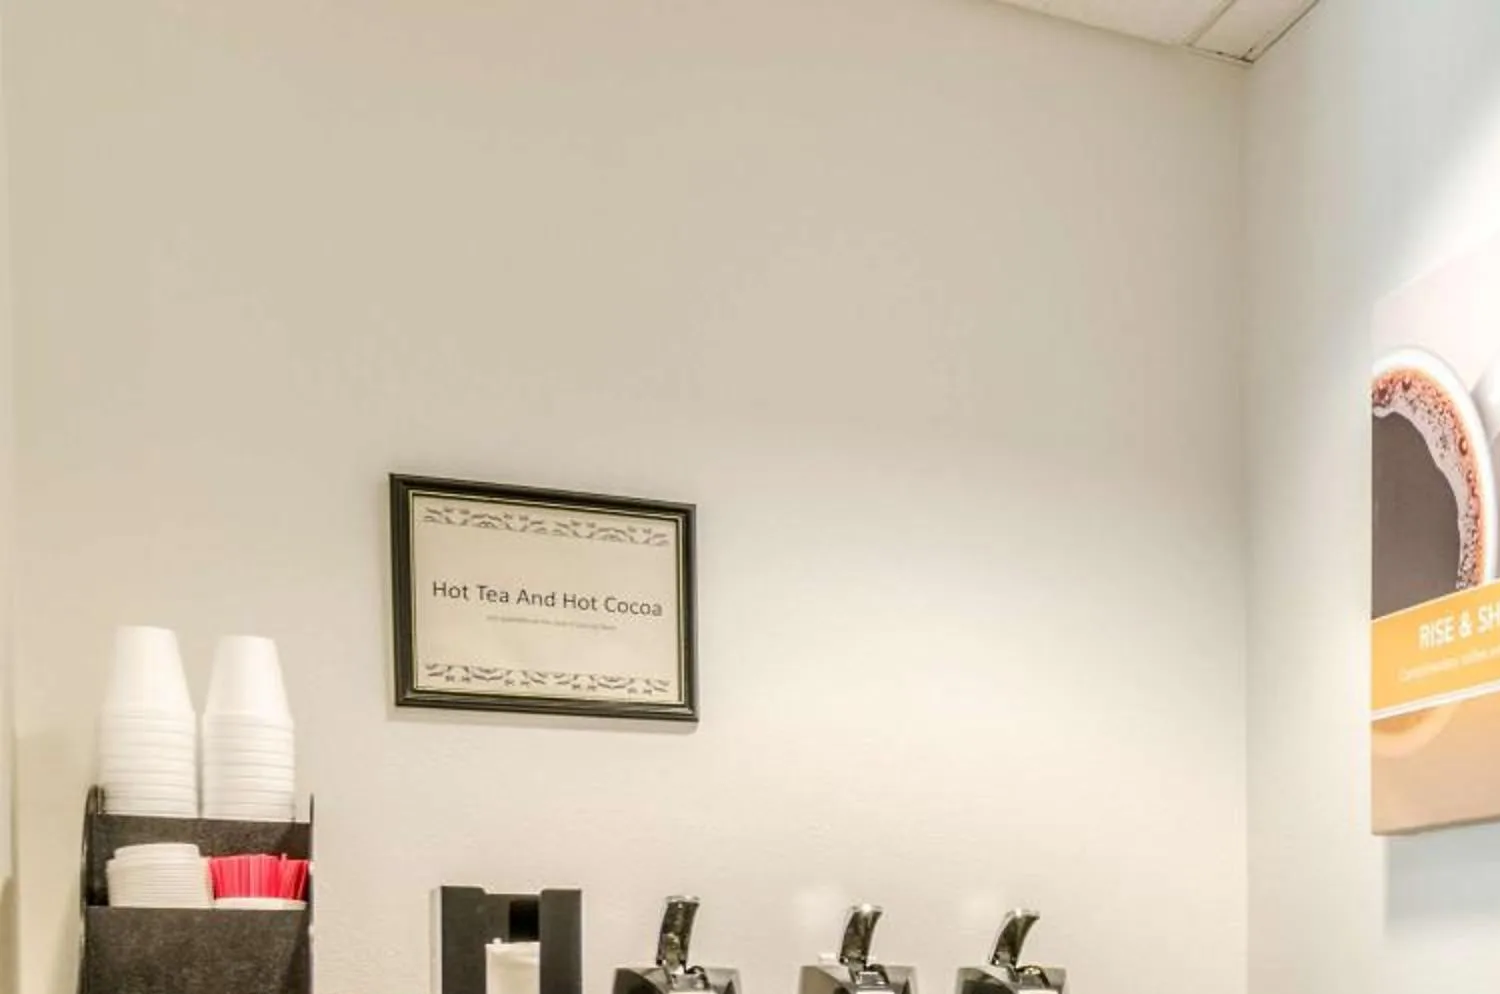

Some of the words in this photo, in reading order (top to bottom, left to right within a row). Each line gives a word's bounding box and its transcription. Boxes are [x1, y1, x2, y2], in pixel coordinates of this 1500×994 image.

[432, 580, 469, 601] Hot
[477, 584, 509, 604] Tea
[516, 588, 556, 608] And
[562, 593, 598, 612] Hot
[604, 596, 663, 617] Cocoa
[1418, 614, 1455, 649] RISE
[1458, 609, 1473, 639] &
